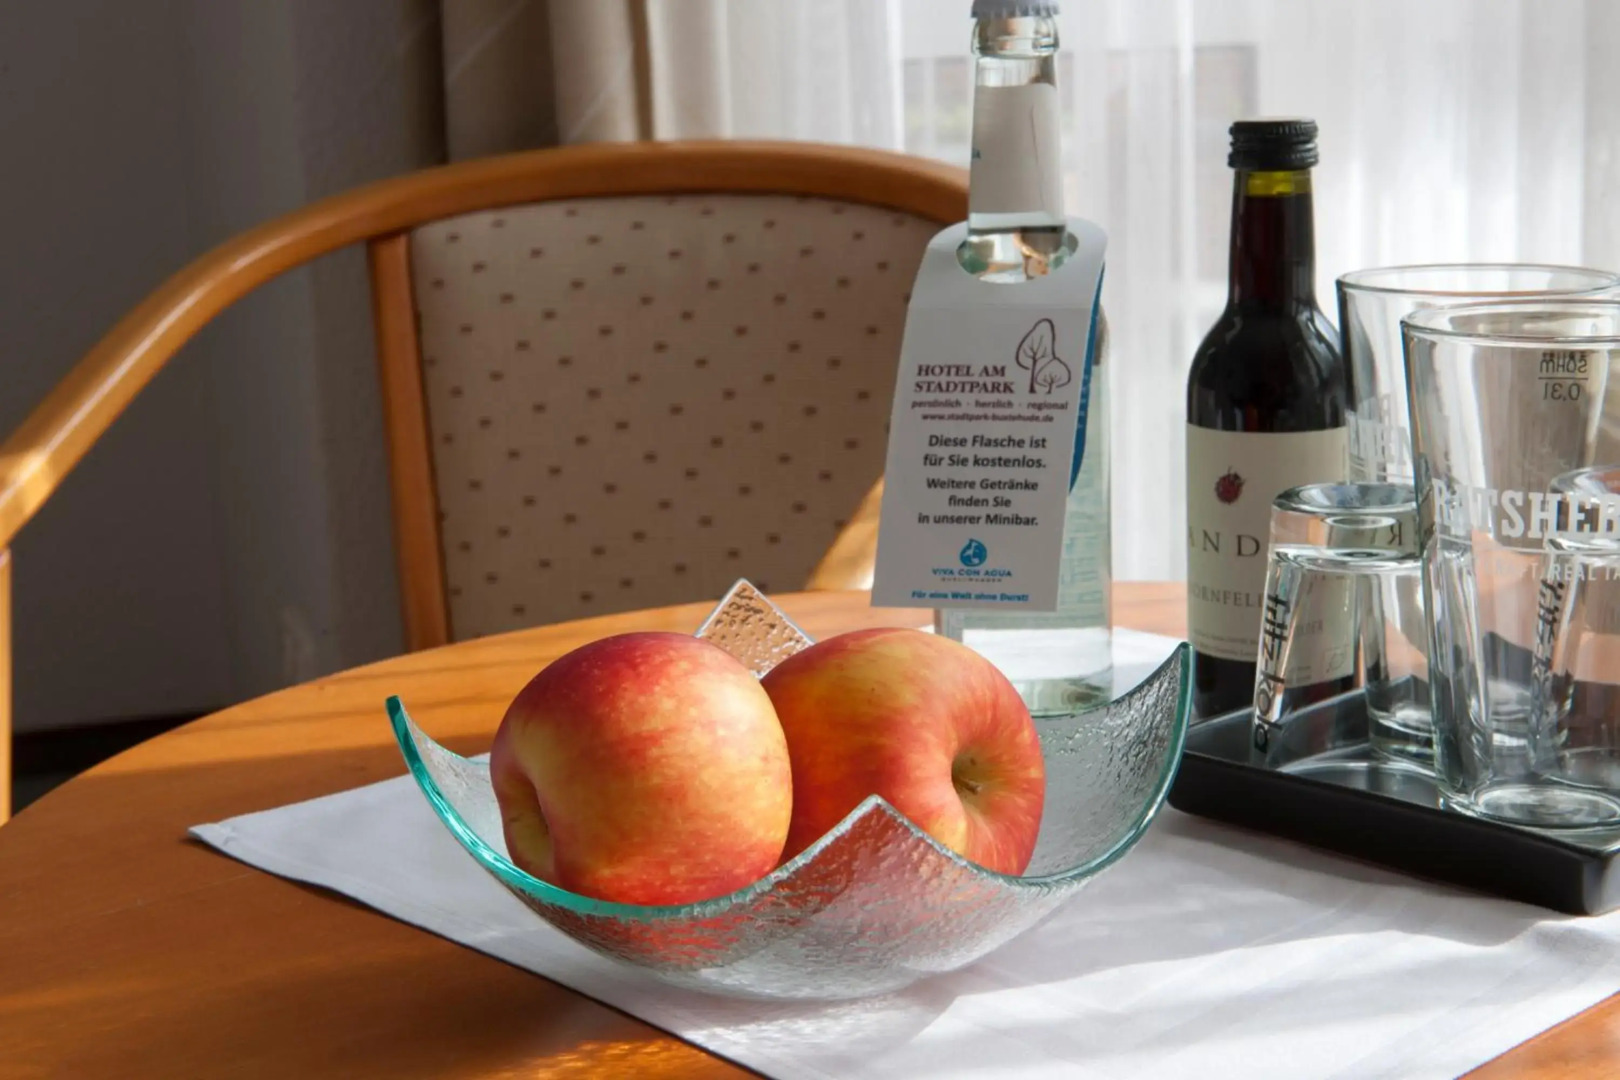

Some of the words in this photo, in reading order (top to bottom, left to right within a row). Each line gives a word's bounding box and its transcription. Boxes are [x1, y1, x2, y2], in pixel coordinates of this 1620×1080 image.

[917, 364, 974, 378] HOTEL
[979, 365, 1007, 378] AM
[914, 380, 1016, 395] STADTPARK
[911, 398, 962, 410] persönlich
[974, 399, 1014, 410] herzlich
[1027, 401, 1069, 411] regional
[921, 412, 1054, 424] www.stadtpark-buxtehude.de
[928, 434, 968, 448] Diese
[971, 434, 1025, 449] Flasche
[1029, 436, 1047, 449] ist
[923, 453, 945, 467] für
[948, 454, 969, 467] Sie
[972, 454, 1047, 469] kostenlos.
[926, 477, 976, 490] Weitere
[980, 478, 1039, 491] Getränke
[948, 494, 989, 508] finden
[992, 496, 1012, 508] Sie
[918, 512, 930, 524] in
[933, 515, 982, 526] unserer
[985, 513, 1039, 527] Minibar.
[932, 568, 954, 576] VIVA
[958, 568, 980, 577] CON
[984, 569, 1012, 577] AGUA
[1551, 563, 1597, 581] REAL
[911, 590, 927, 600] Für
[929, 591, 949, 600] eine
[950, 591, 972, 601] Welt
[974, 591, 998, 601] ohne
[1000, 592, 1029, 602] Durst!
